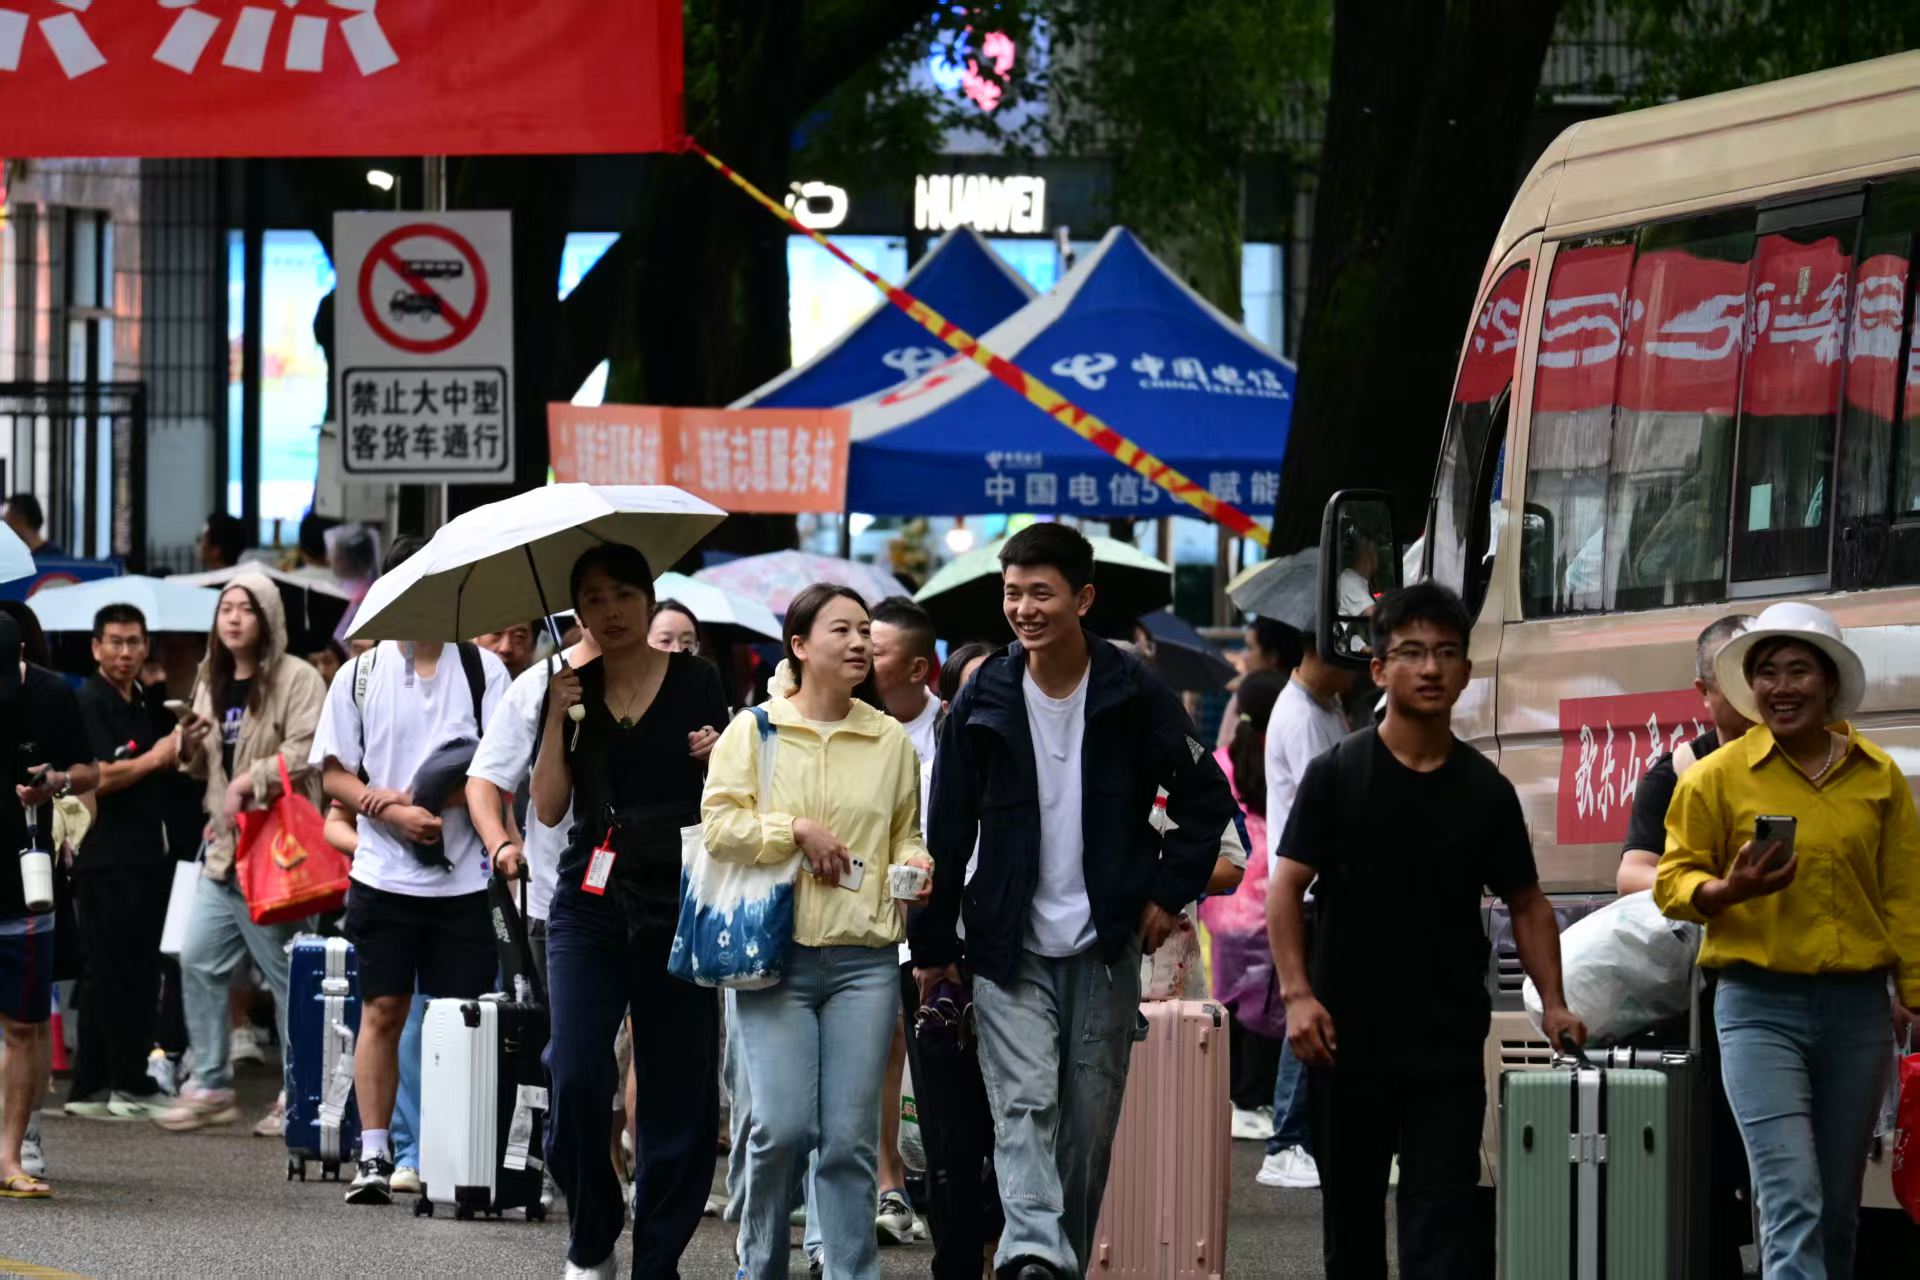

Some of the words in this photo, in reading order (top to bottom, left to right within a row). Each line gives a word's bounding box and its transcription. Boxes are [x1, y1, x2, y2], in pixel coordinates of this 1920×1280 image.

[914, 174, 1045, 233] HUAWEI
[351, 378, 499, 416] 禁止大中型
[351, 423, 499, 460] 客货车通行
